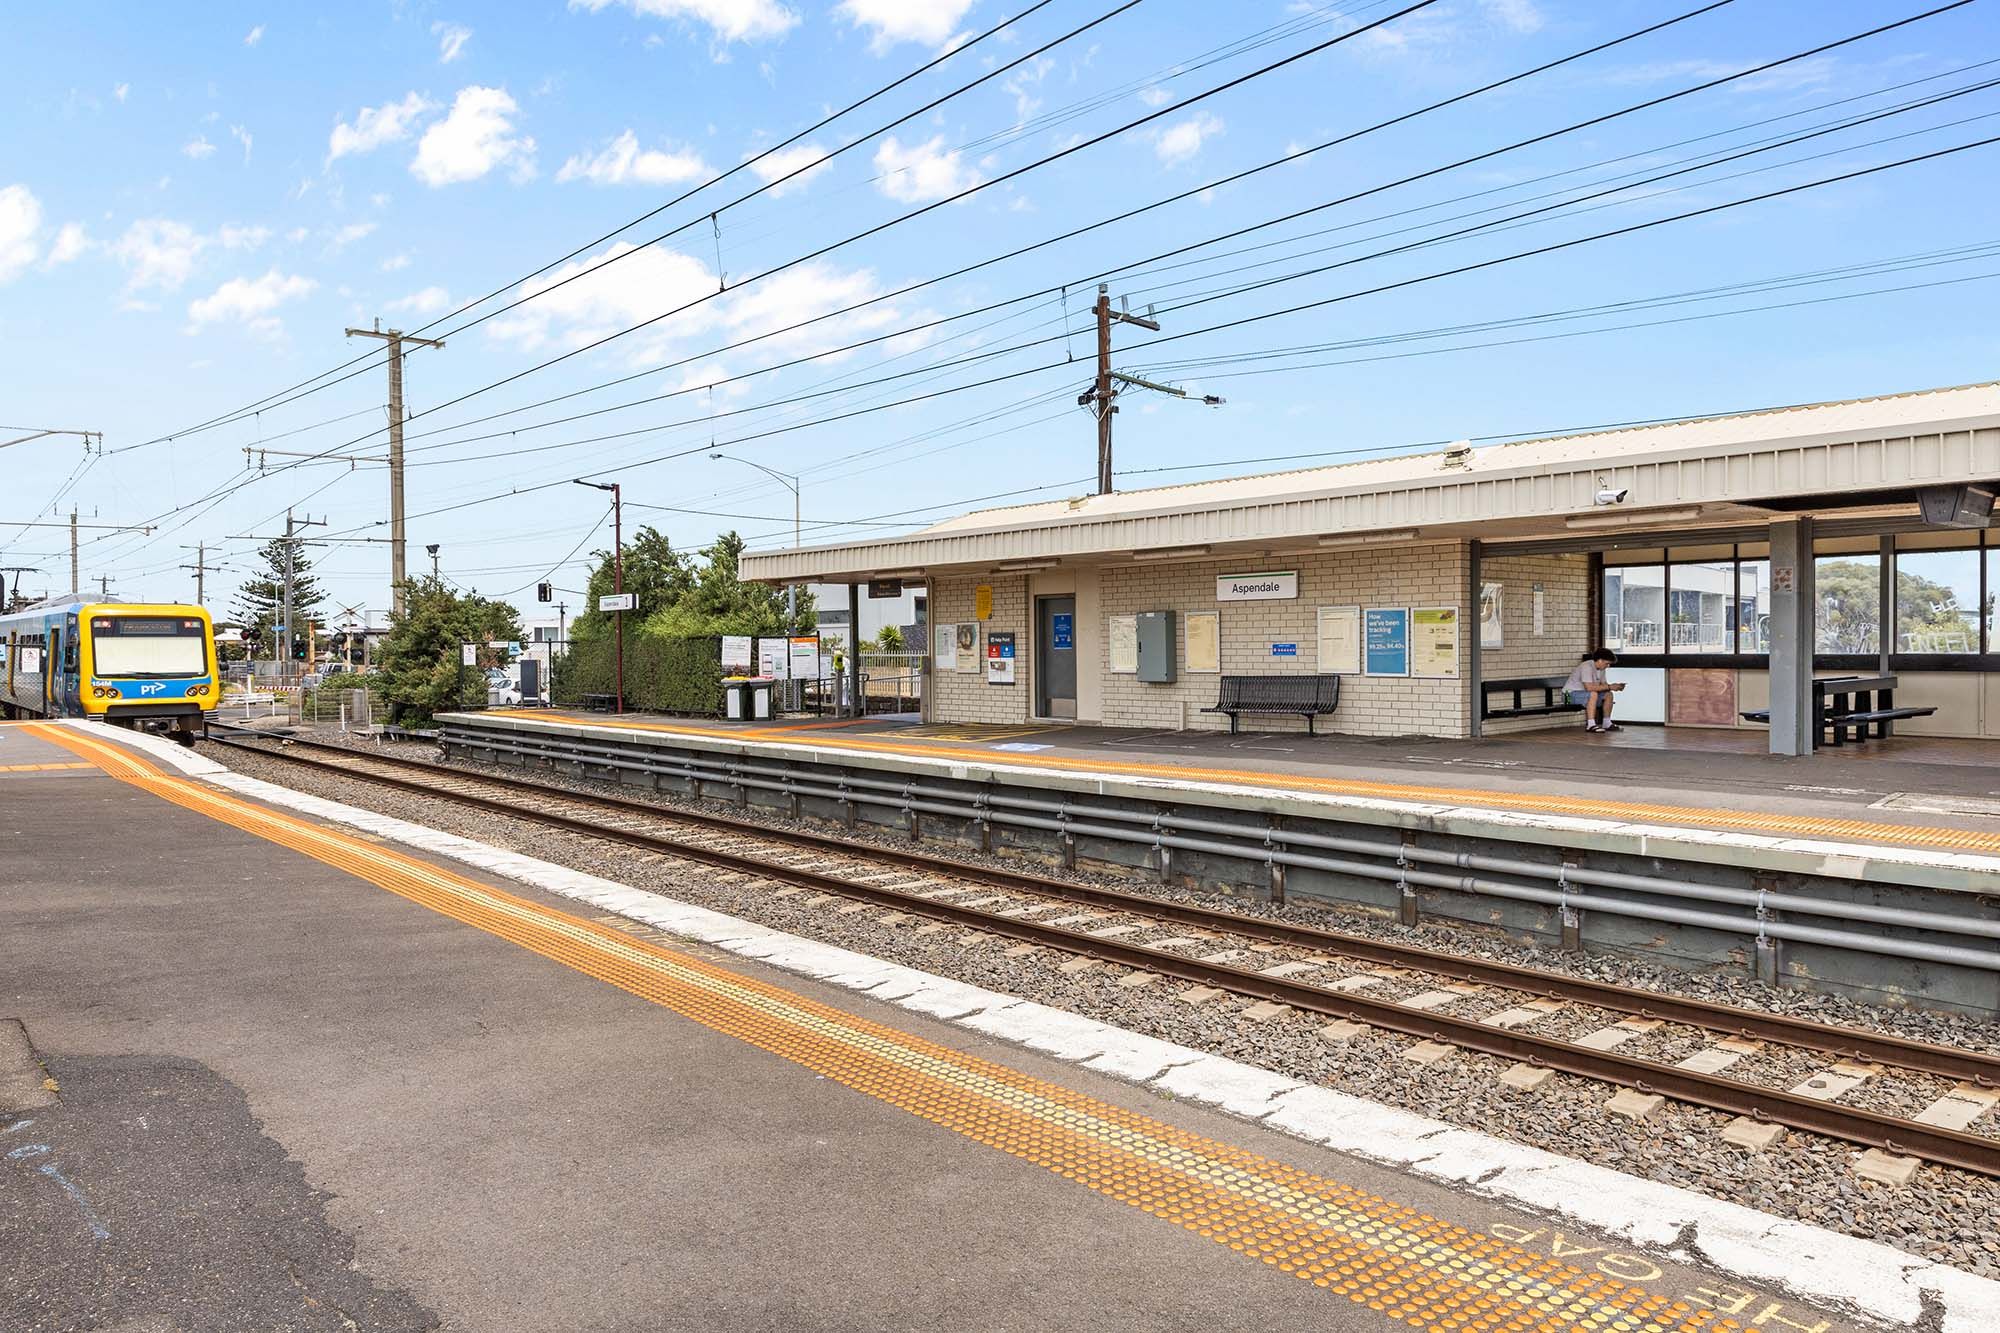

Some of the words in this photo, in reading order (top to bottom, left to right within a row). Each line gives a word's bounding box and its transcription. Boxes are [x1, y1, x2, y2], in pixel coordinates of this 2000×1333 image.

[1232, 581, 1280, 595] Aspendale
[1487, 1221, 1663, 1283] GAP
[1685, 1280, 1831, 1333] HE
